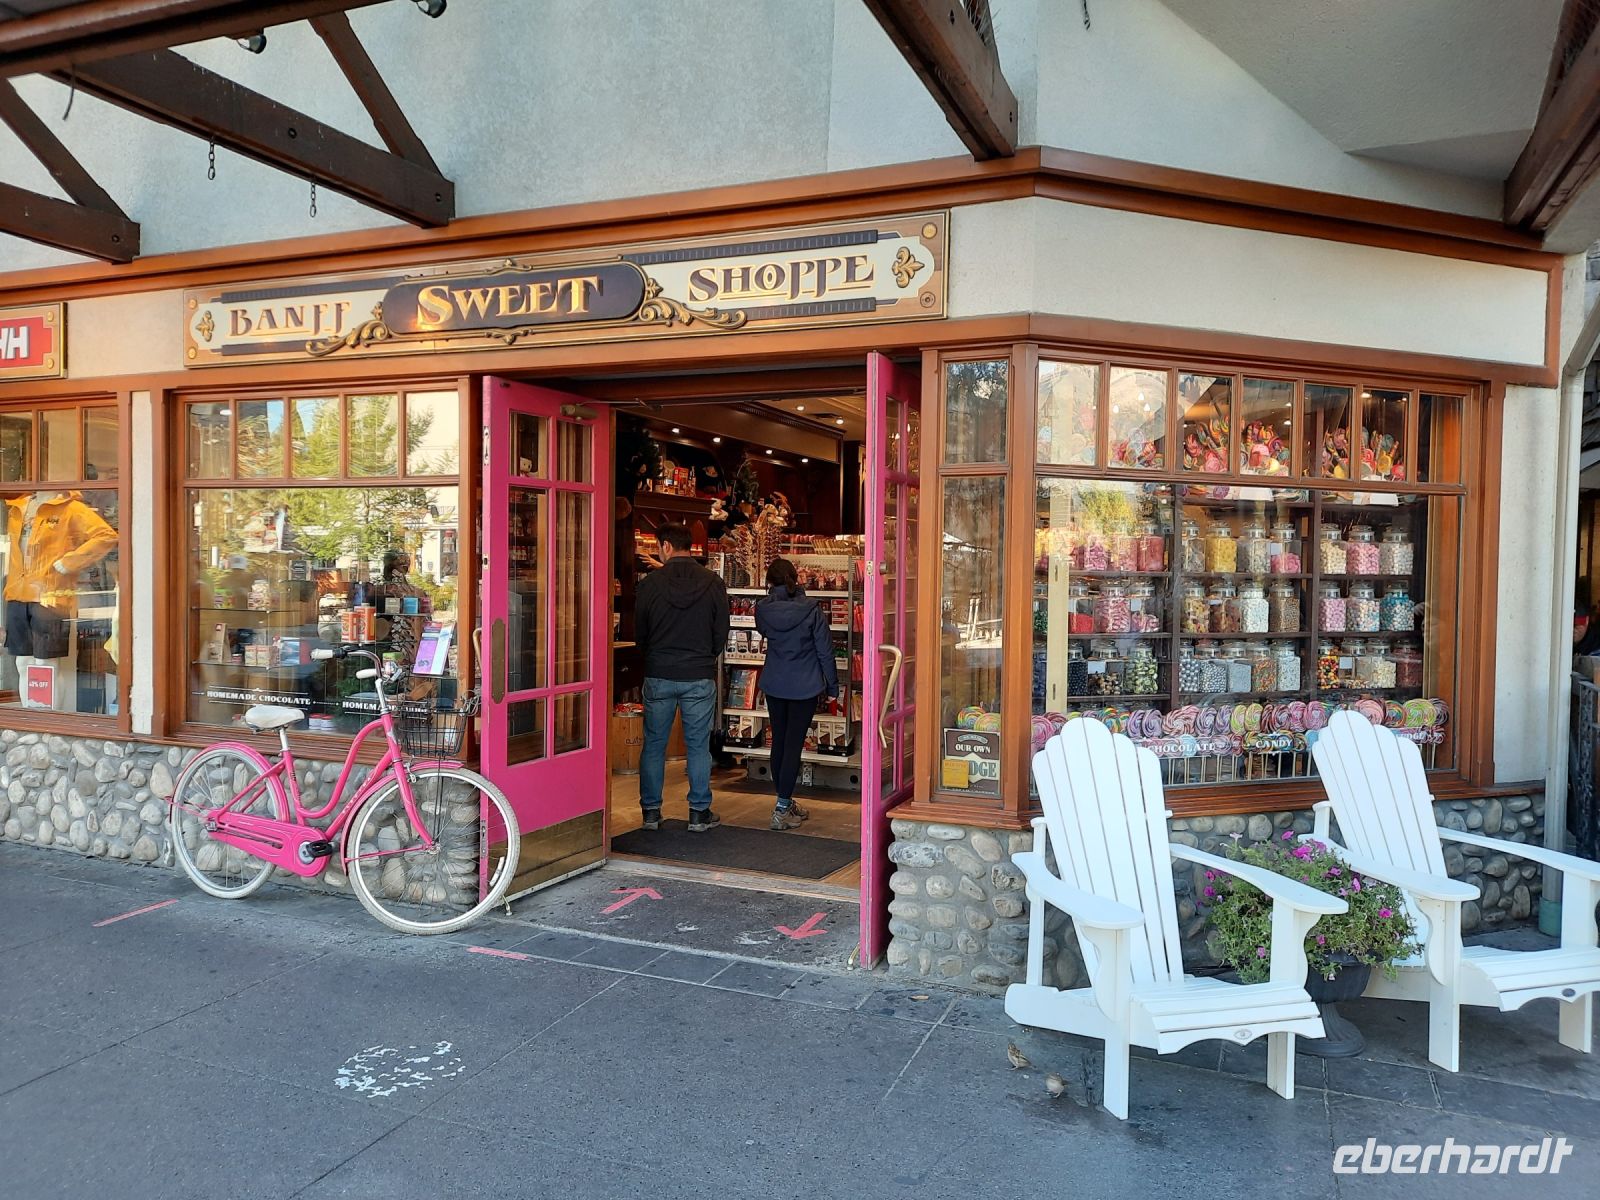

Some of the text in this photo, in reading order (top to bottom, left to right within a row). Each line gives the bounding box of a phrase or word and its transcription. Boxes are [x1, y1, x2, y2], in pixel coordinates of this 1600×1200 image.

[228, 254, 876, 337] BANFF SWEET SHOPPE
[207, 690, 310, 705] HOMEMADE CHOCOLATE
[955, 743, 991, 753] OUR OWN
[1255, 739, 1293, 749] CANDY
[968, 760, 997, 778] DGE
